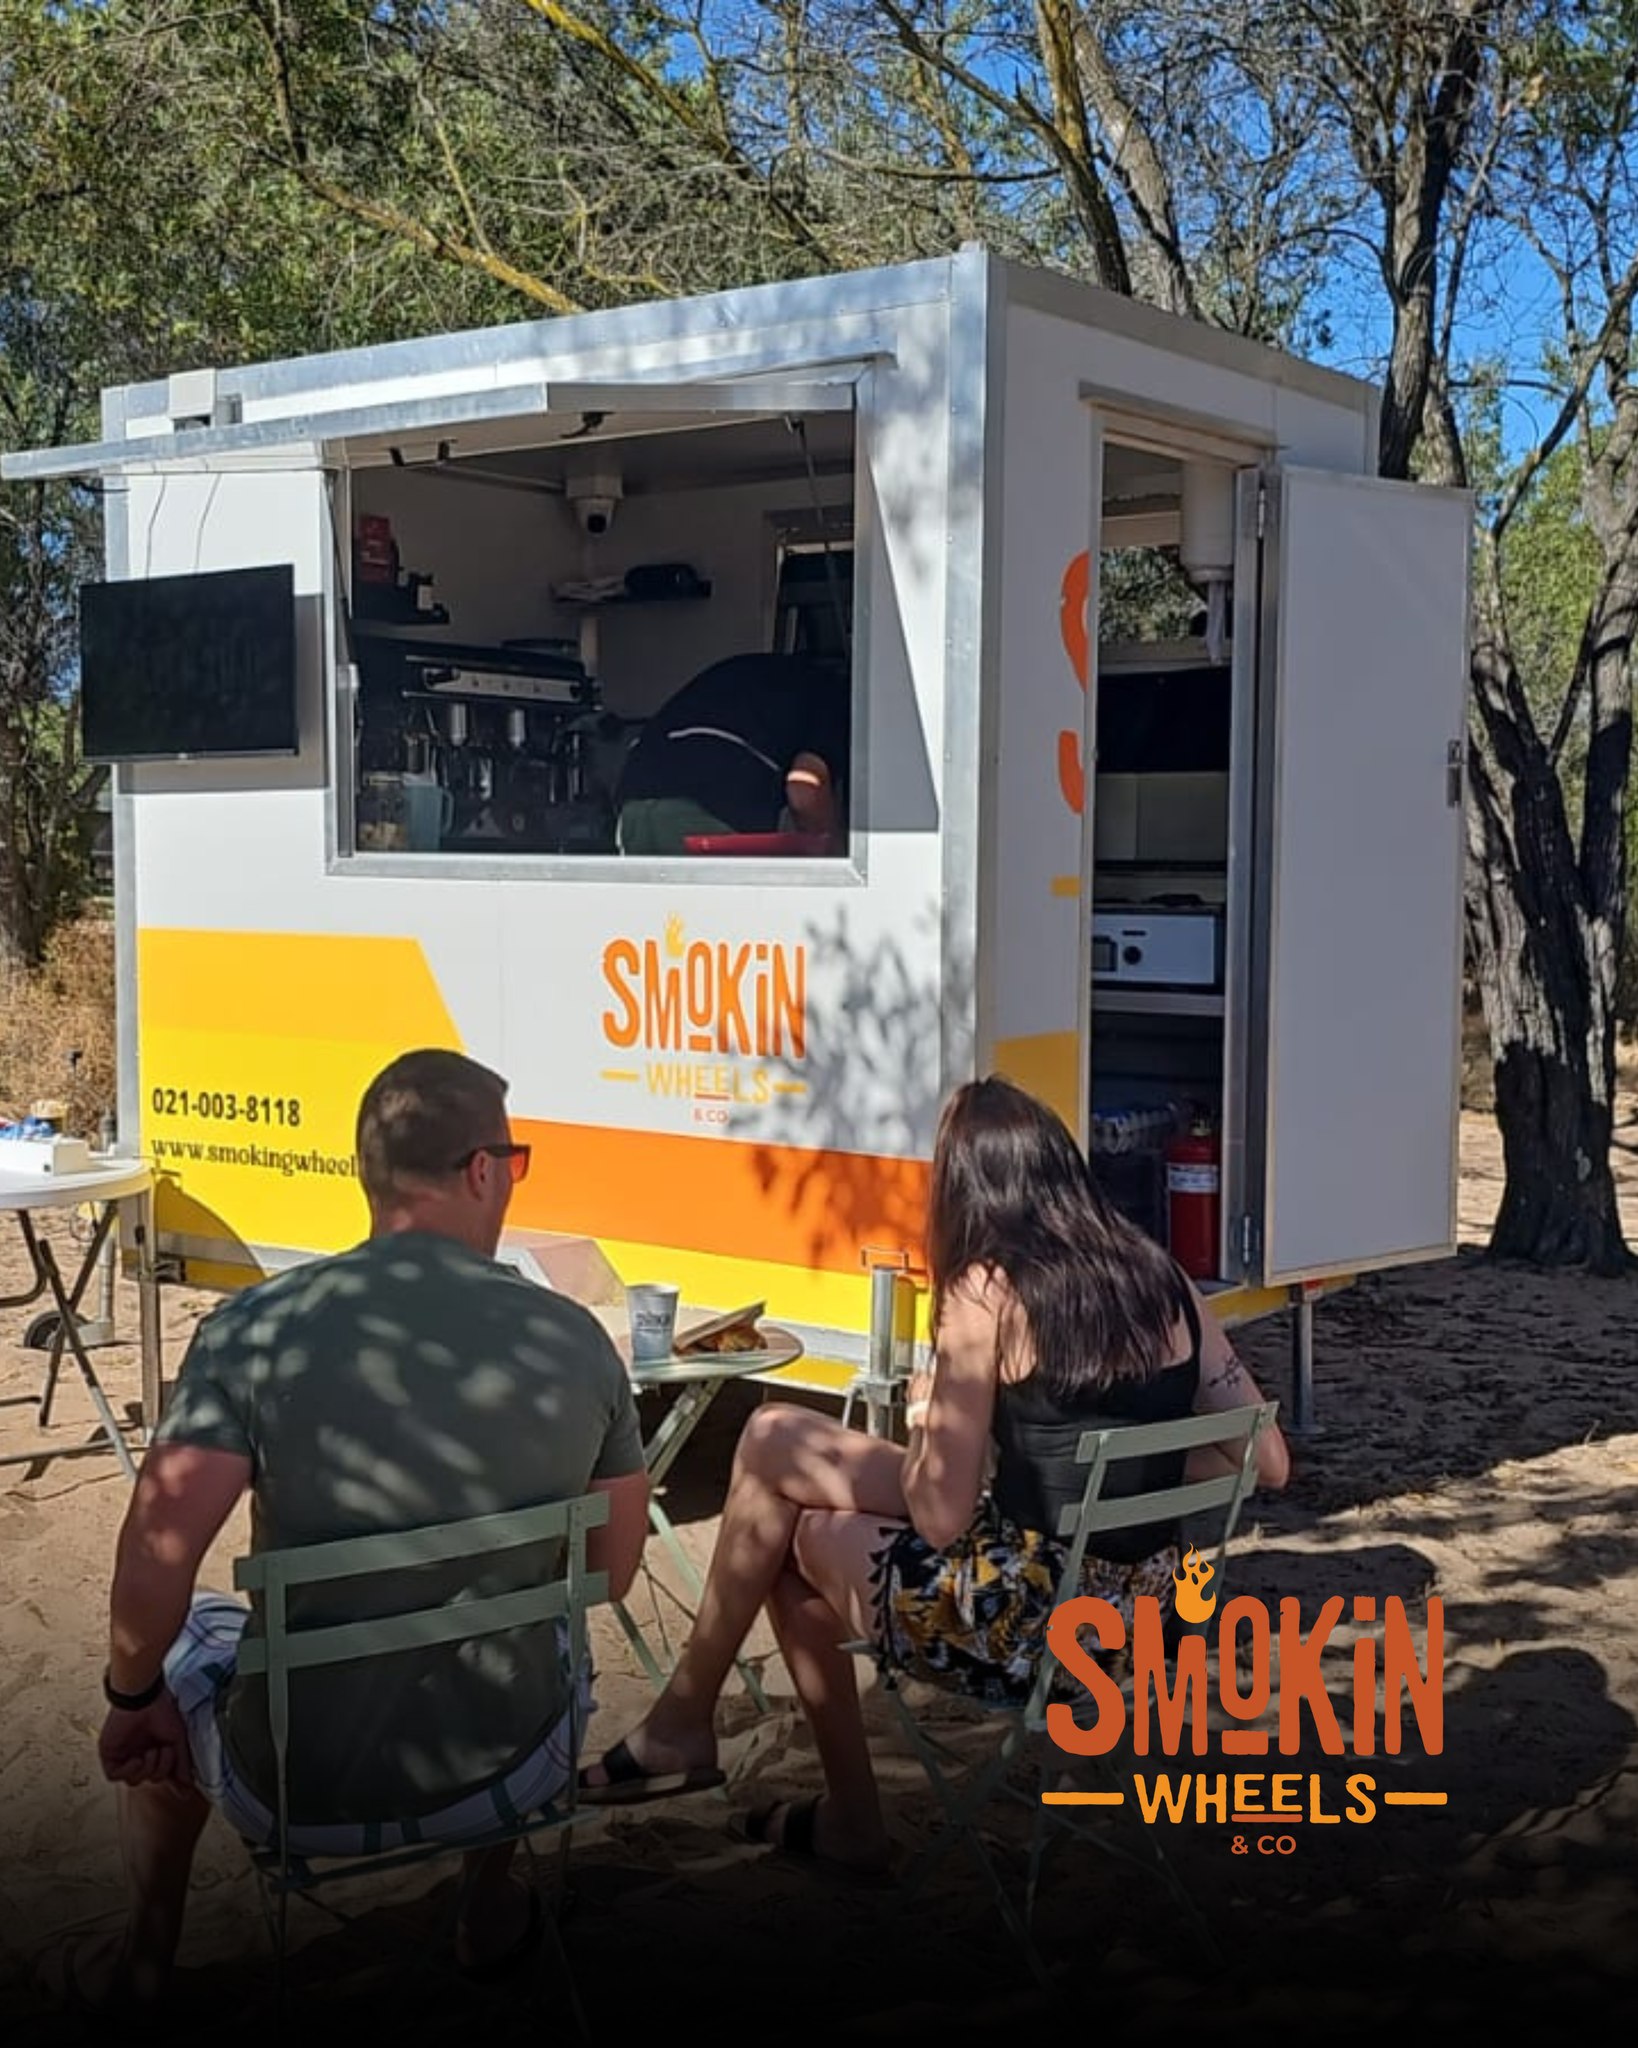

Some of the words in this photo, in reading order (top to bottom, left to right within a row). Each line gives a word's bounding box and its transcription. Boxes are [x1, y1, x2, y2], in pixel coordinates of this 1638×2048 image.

[646, 1063, 769, 1103] WHEELS
[152, 1088, 301, 1126] 021-003-8118
[705, 1109, 728, 1123] CO
[151, 1139, 357, 1177] www.smokingwheel
